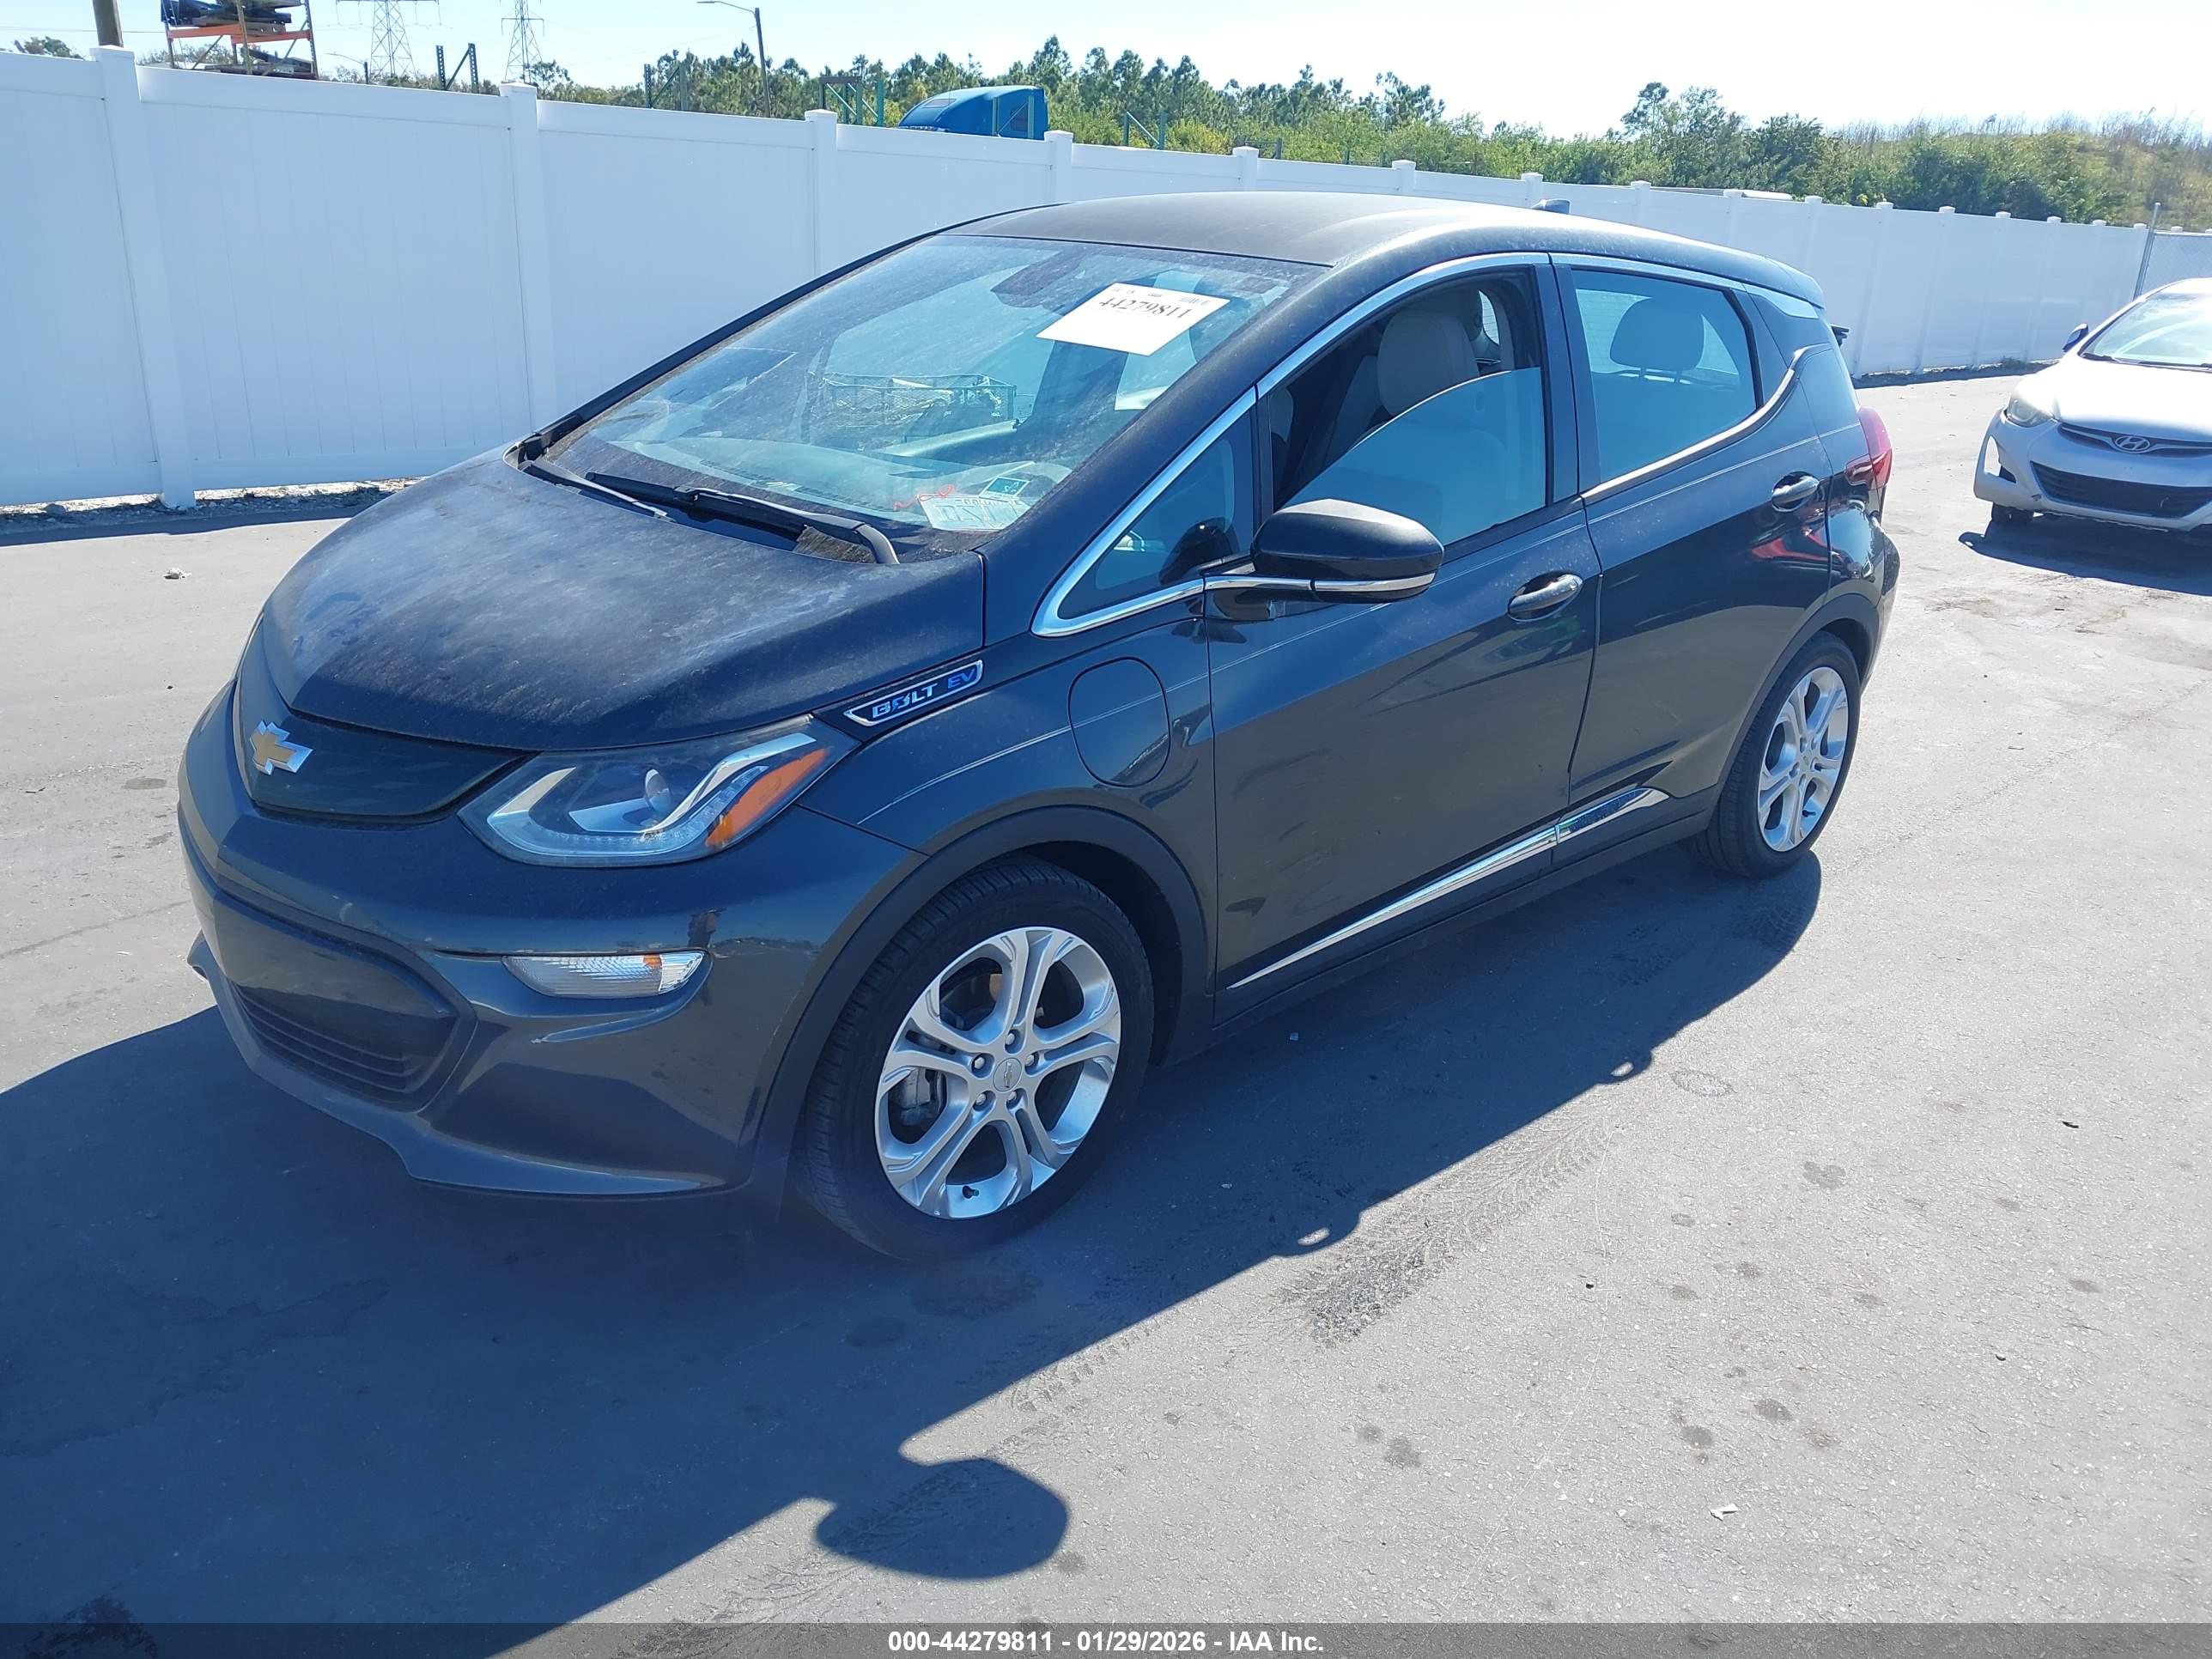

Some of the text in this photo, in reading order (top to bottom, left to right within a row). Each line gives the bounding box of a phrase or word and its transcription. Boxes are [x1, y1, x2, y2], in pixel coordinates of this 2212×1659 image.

[1098, 296, 1193, 319] 44279811
[872, 668, 975, 719] BOLT EV
